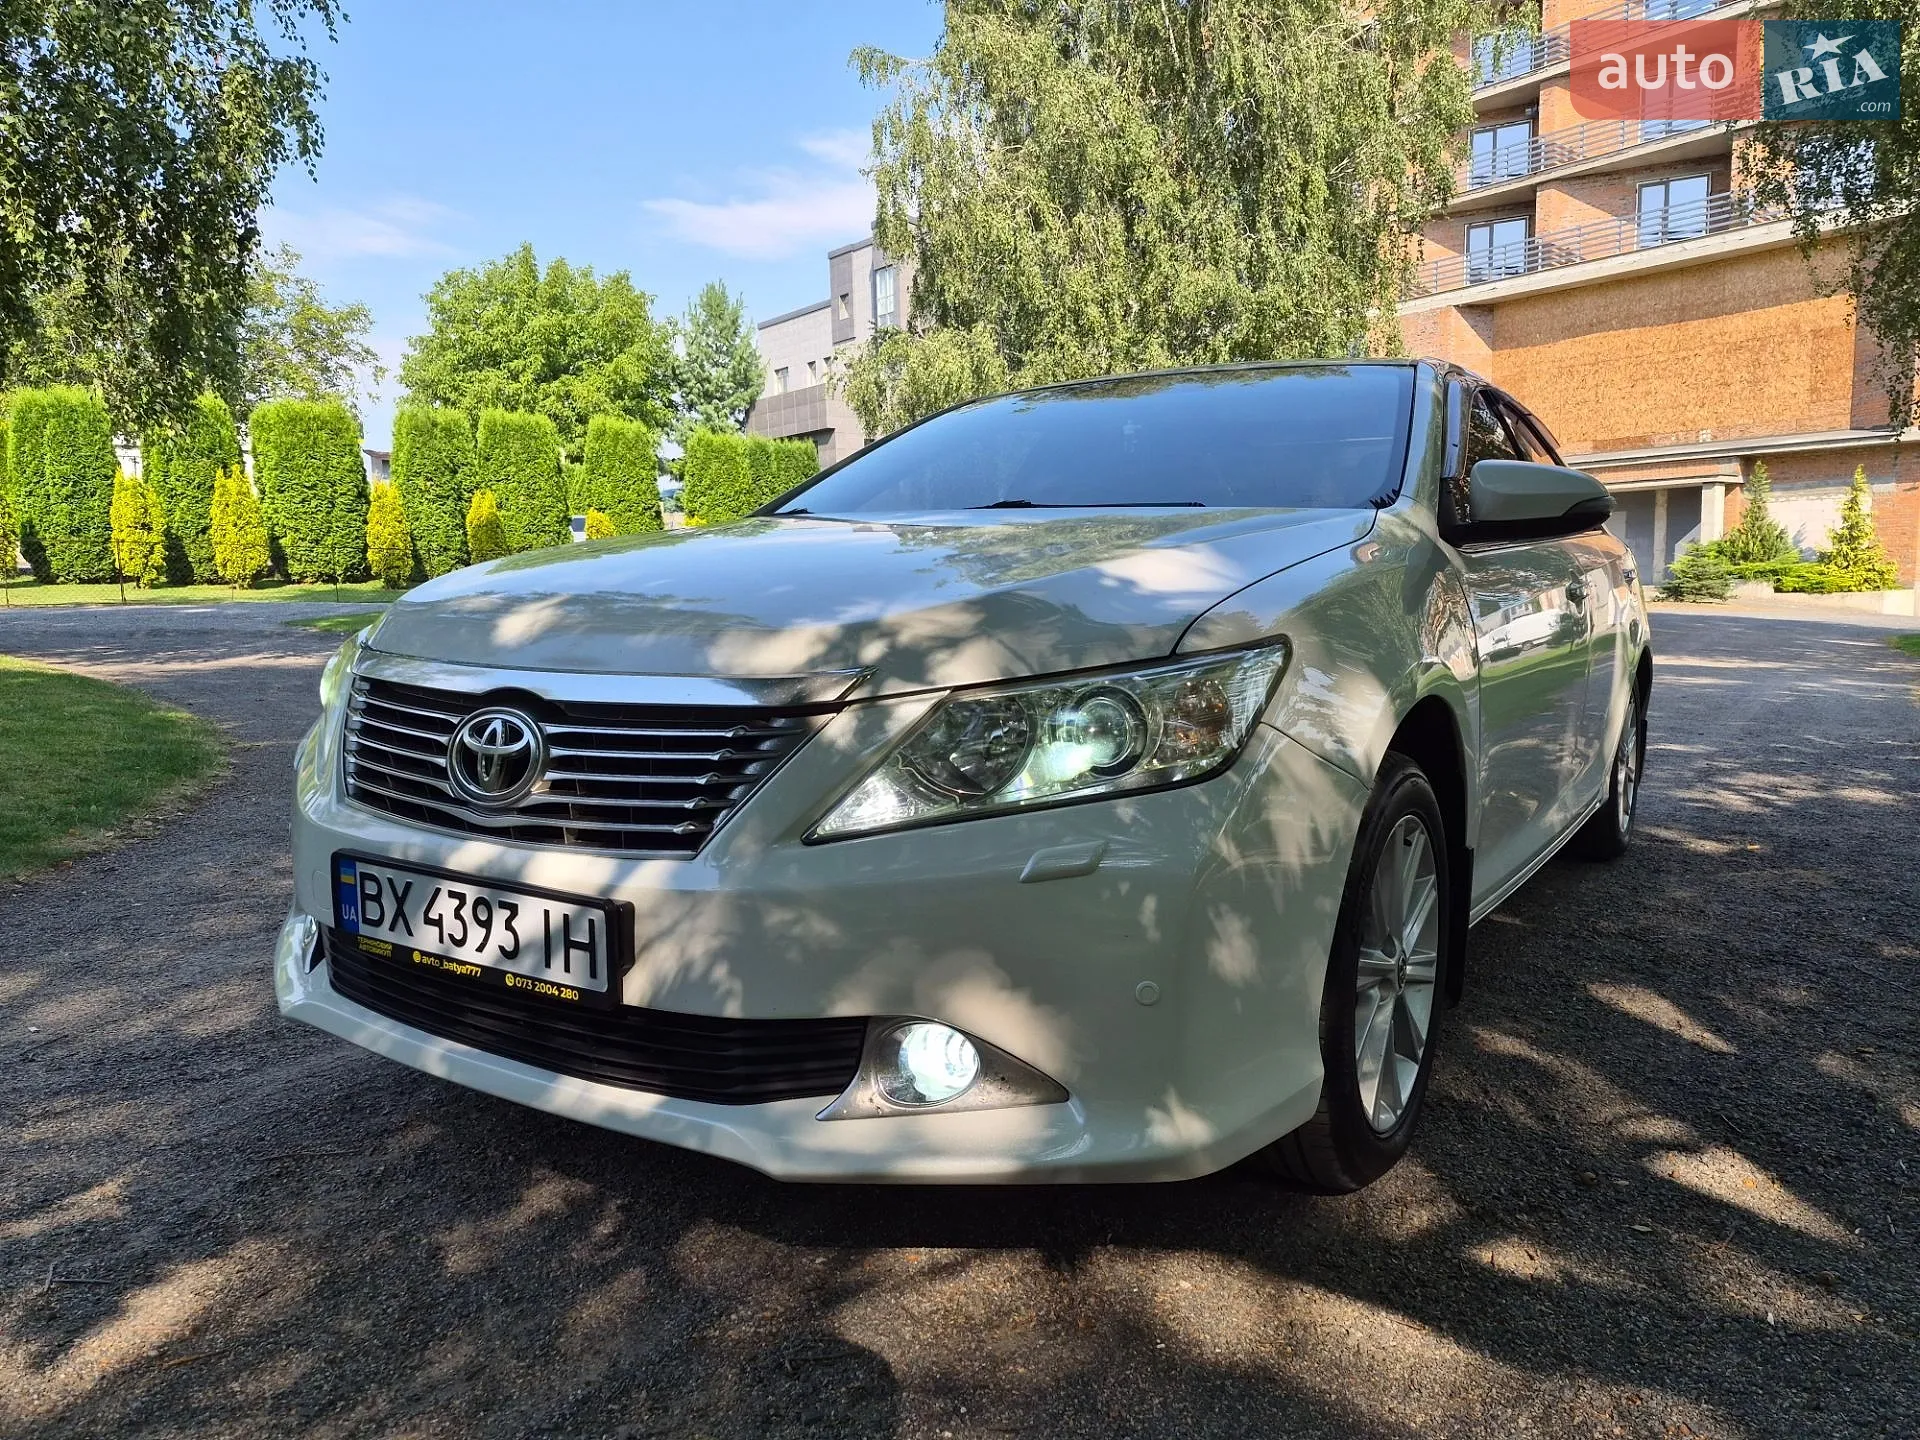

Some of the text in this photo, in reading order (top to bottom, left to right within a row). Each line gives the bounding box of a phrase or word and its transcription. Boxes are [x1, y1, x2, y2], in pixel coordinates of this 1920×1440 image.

[342, 903, 357, 922] UA
[359, 870, 598, 979] BX 4393 IH
[515, 977, 579, 1001] 073 2004 280
